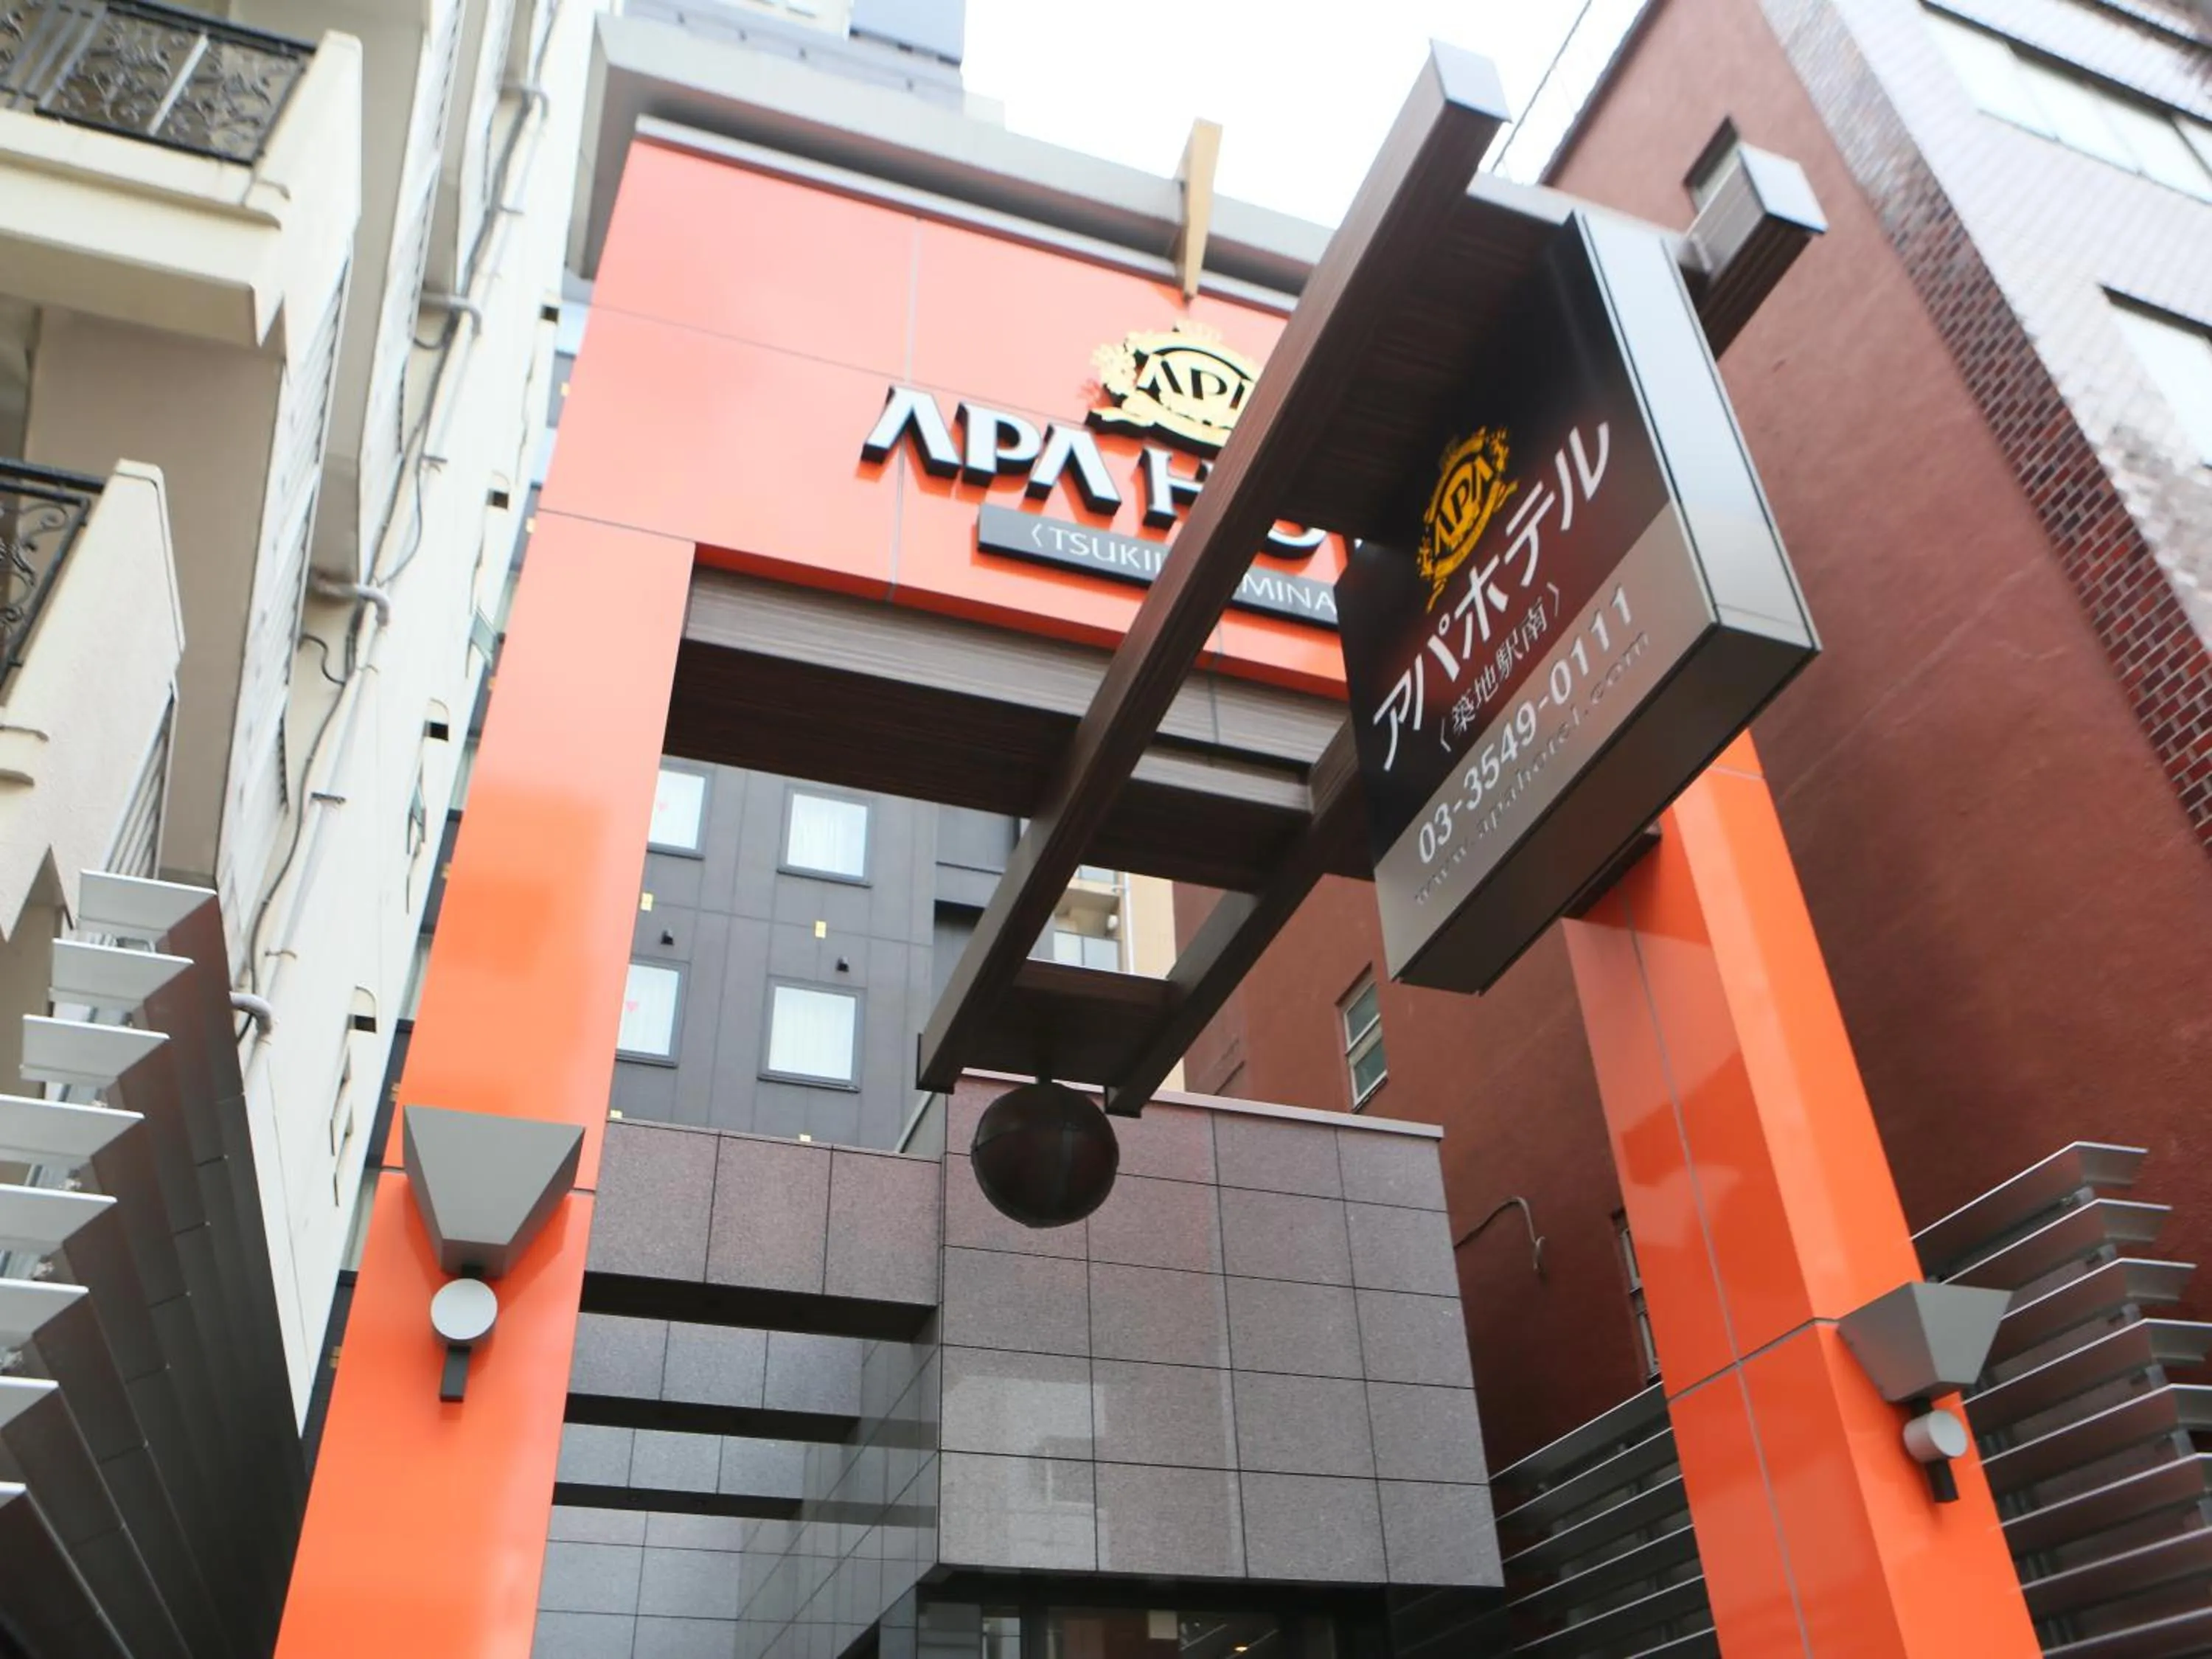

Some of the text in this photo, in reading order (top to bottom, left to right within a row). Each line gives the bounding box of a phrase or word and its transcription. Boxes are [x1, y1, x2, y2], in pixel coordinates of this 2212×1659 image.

[861, 386, 1121, 513] APA
[1435, 455, 1494, 557] APA
[1373, 422, 1610, 771] アパホテル
[1419, 586, 1633, 864] 03-3549-0111
